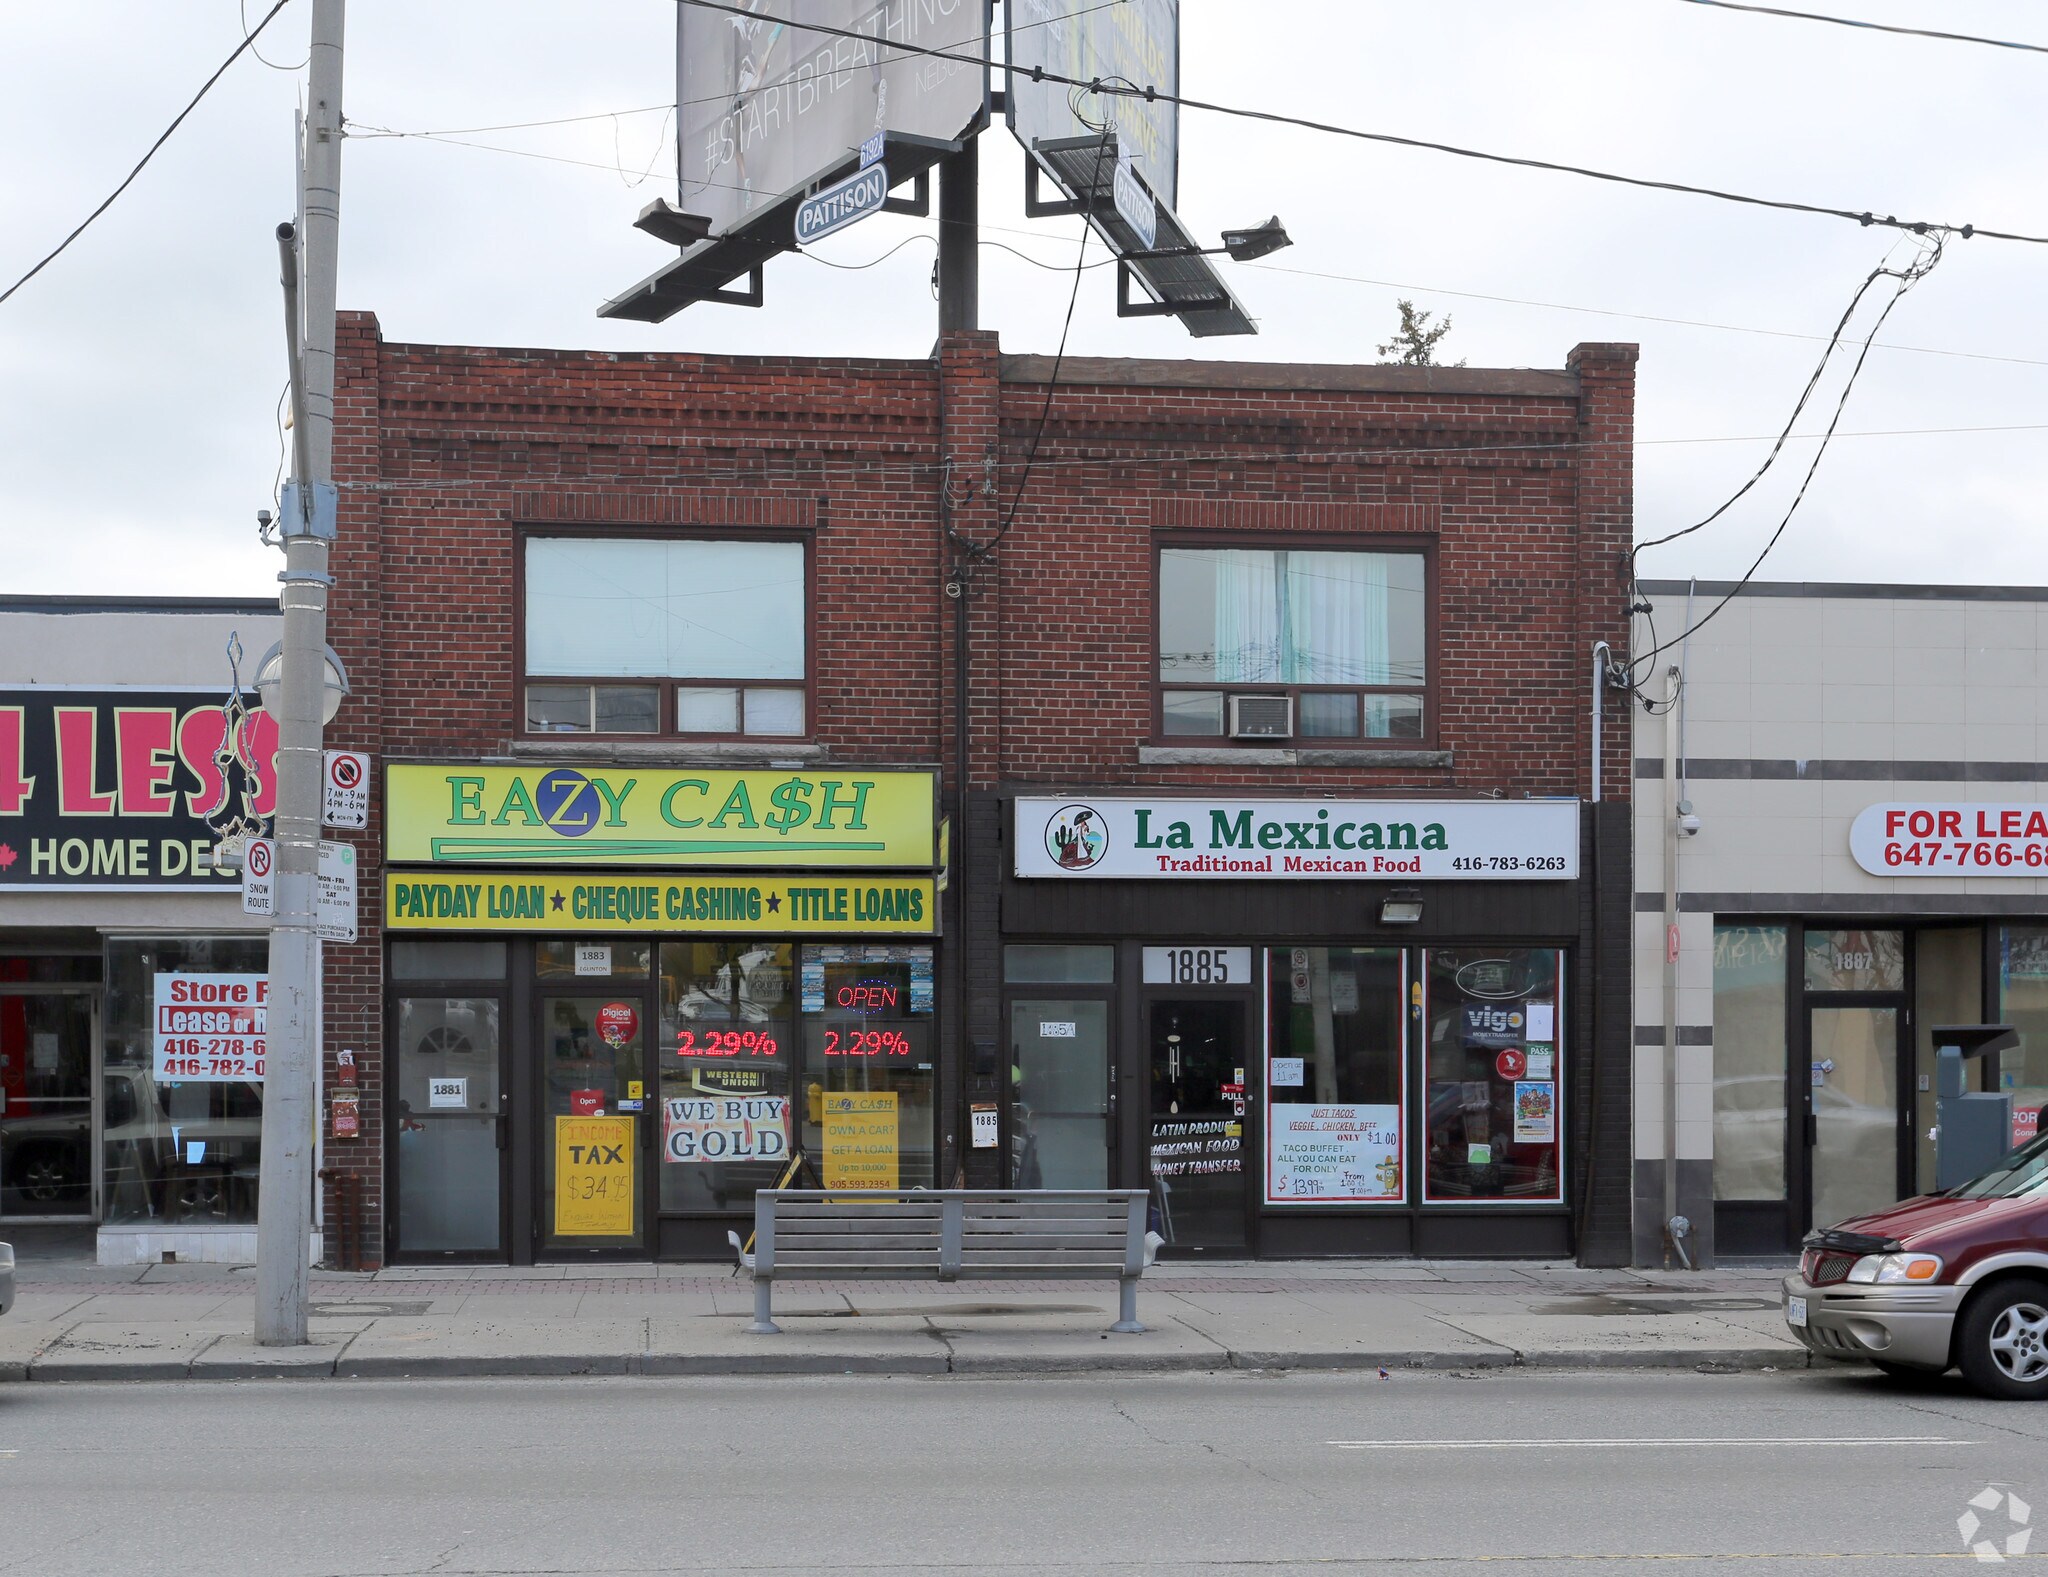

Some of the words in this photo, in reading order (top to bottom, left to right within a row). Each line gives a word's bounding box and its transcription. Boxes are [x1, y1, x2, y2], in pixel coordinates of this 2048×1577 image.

[860, 133, 884, 165] 6192A
[803, 175, 880, 233] PATTISON
[1117, 175, 1155, 240] PATTISON
[327, 788, 333, 798] 7
[334, 791, 344, 799] AM
[349, 790, 355, 800] 9
[356, 792, 366, 800] AM
[327, 798, 333, 808] 4
[333, 800, 344, 809] PM
[349, 800, 355, 810] 6
[356, 802, 366, 810] PM
[445, 769, 637, 837] EAZY
[659, 777, 876, 836] CA$H
[1134, 809, 1194, 849] La
[1208, 808, 1449, 850] Mexicana
[1885, 810, 1962, 838] FOR
[30, 838, 150, 877] HOME
[1884, 842, 2048, 867] 647-766-6
[1156, 855, 1273, 873] Traditional
[1283, 855, 1367, 873] Mexican
[1372, 855, 1422, 873] Food
[1451, 856, 1567, 871] 416-783-6263
[249, 883, 269, 895] SNOW
[247, 896, 269, 909] ROUTE
[394, 883, 483, 919] PAYDAY
[487, 885, 546, 919] LOAN
[572, 886, 659, 925] CHEQUE
[664, 886, 762, 922] CASHING
[787, 887, 848, 922] TITLE
[853, 887, 924, 923] LOANS
[581, 951, 605, 961] 1883
[1835, 952, 1873, 970] 1887
[1167, 949, 1228, 984] 1885
[170, 979, 249, 1003] Store
[837, 987, 897, 1007] OPEN
[161, 1007, 231, 1034] Lease
[233, 1018, 251, 1034] or
[602, 1008, 631, 1019] Digicel
[1467, 1005, 1524, 1032] vigo
[677, 1031, 778, 1057] 2.29%
[824, 1031, 911, 1056] 2.29%
[1530, 1047, 1549, 1055] PASS
[1272, 1060, 1293, 1071] Open
[706, 1070, 757, 1079] WESTERN
[433, 1084, 462, 1095] 1881
[722, 1078, 757, 1087] UNION
[579, 1097, 597, 1106] Open
[1221, 1092, 1244, 1100] PULL
[670, 1102, 715, 1120] WE
[725, 1101, 783, 1119] BUY
[828, 1098, 857, 1110] EAZY
[975, 1115, 997, 1126] 1885
[1311, 1108, 1330, 1118] JUST
[1331, 1108, 1356, 1118] TACOS
[567, 1126, 623, 1141] INCOME
[829, 1125, 856, 1135] OWN
[858, 1126, 867, 1135] A
[868, 1125, 895, 1135] CAR?
[1152, 1122, 1188, 1137] LATIN
[671, 1130, 784, 1157] GOLD
[1337, 1134, 1360, 1142] ONLY
[1367, 1131, 1397, 1145] $1.00
[568, 1144, 625, 1165] TAX
[831, 1145, 852, 1155] GET
[854, 1146, 862, 1155] A
[864, 1145, 893, 1155] LOAN
[1151, 1141, 1203, 1156] MEXICAN
[1205, 1139, 1240, 1153] FOOD
[1283, 1144, 1308, 1152] TACO
[1277, 1155, 1294, 1163] ALL
[1297, 1155, 1316, 1163] YOU
[1318, 1155, 1337, 1163] CAN
[1339, 1155, 1357, 1163] EAT
[838, 1164, 849, 1173] Up
[861, 1164, 887, 1172] 10,000
[1152, 1161, 1187, 1176] MONEY
[1188, 1159, 1242, 1175] TRANSFER
[1293, 1165, 1312, 1173] FOR
[1314, 1165, 1338, 1173] ONLY
[1344, 1171, 1366, 1182] From
[830, 1180, 890, 1189] 905.593.2354
